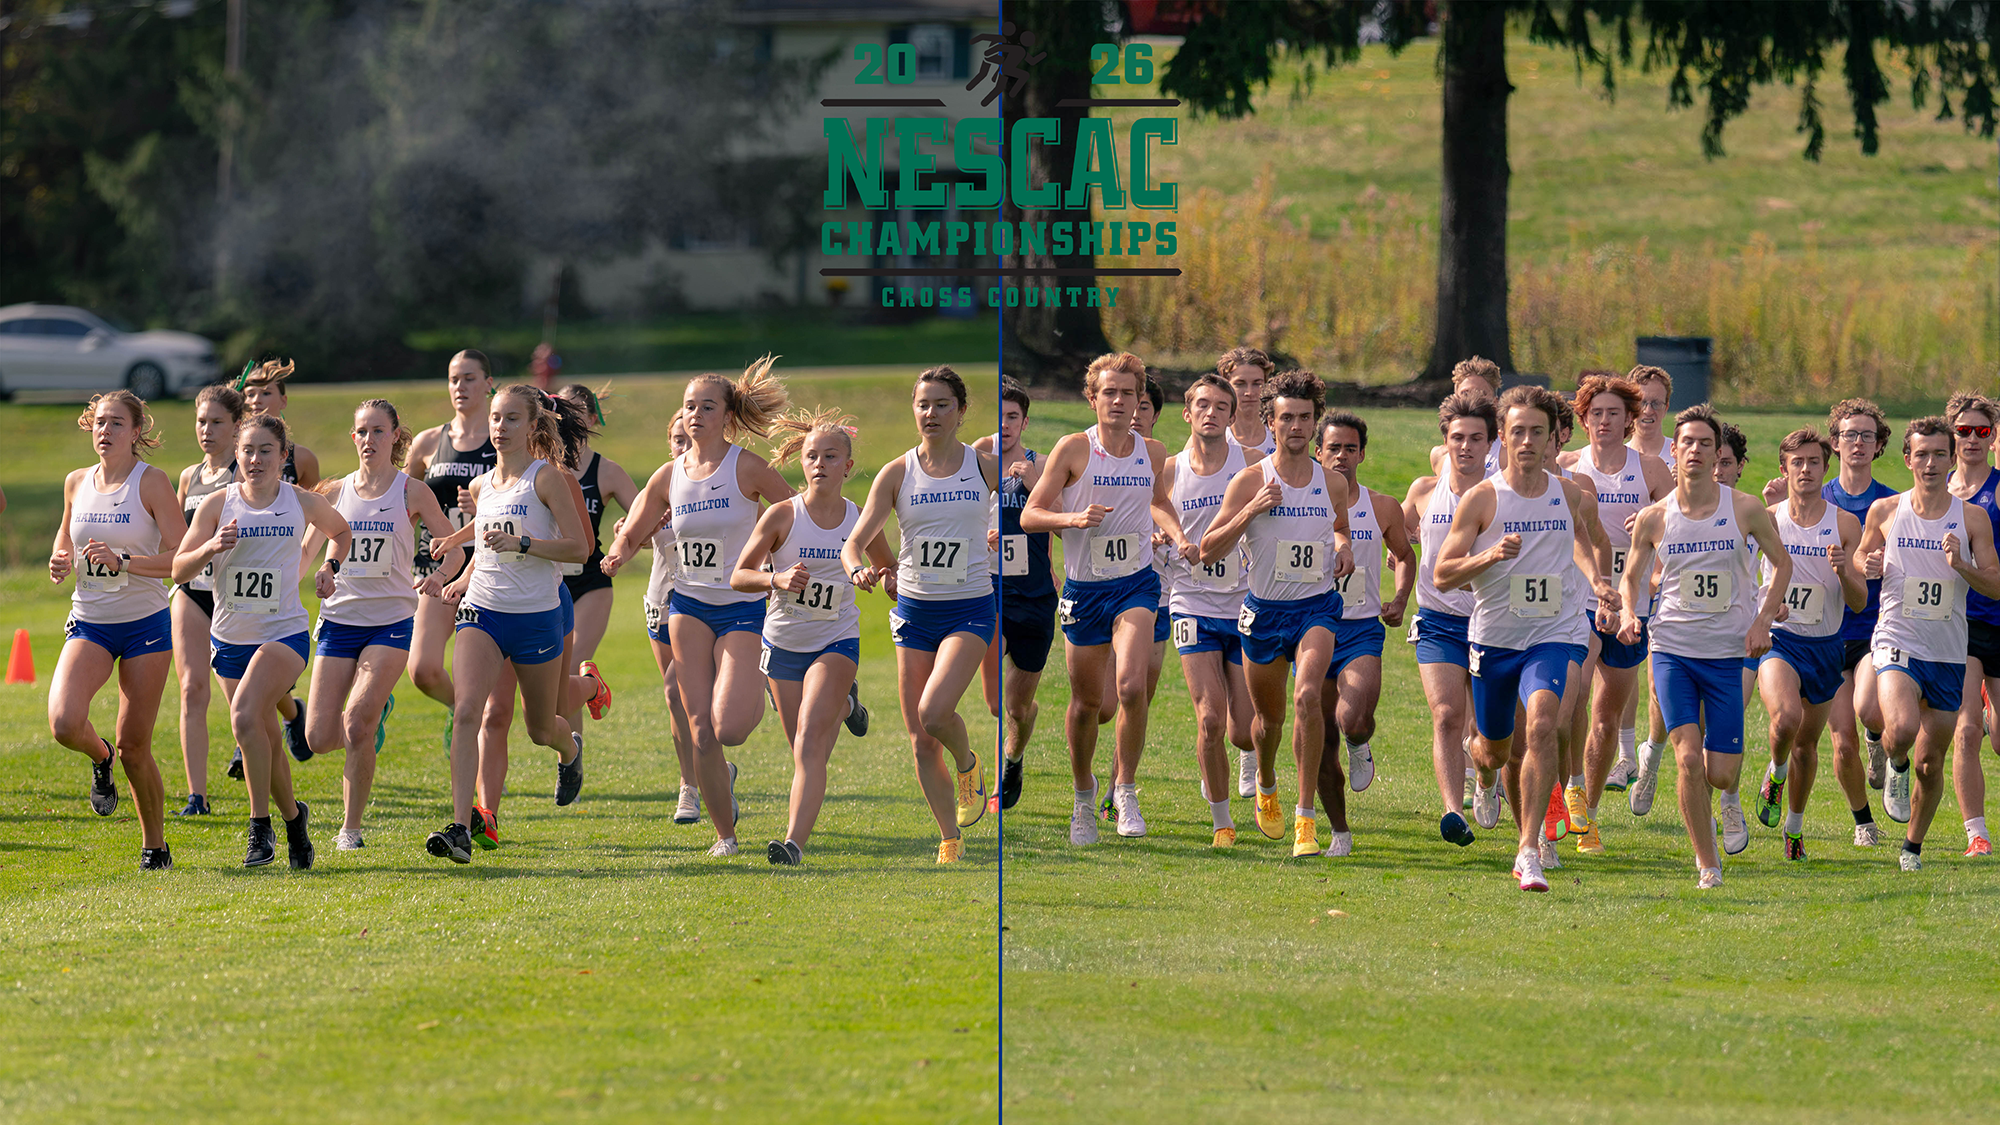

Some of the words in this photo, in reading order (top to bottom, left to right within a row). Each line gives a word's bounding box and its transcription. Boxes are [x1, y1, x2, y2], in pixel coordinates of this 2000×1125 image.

[1093, 475, 1151, 487] HAMILTON
[675, 498, 730, 517] HAMILTON
[910, 490, 980, 506] HAMILTON
[75, 512, 131, 524] HAMILTON
[1269, 505, 1328, 517] HAMILTON
[1504, 520, 1567, 533] HAMILTON
[349, 538, 385, 562] 137
[682, 542, 716, 567] 132
[920, 541, 961, 568] 127
[1105, 538, 1128, 562] 40
[1290, 545, 1313, 568] 38
[1668, 540, 1734, 554] HAMILTON
[85, 554, 119, 577] 12
[234, 571, 274, 599] 126
[796, 582, 834, 610] 131
[1525, 578, 1548, 602] 51
[1694, 574, 1718, 598] 35
[1918, 581, 1942, 606] 39
